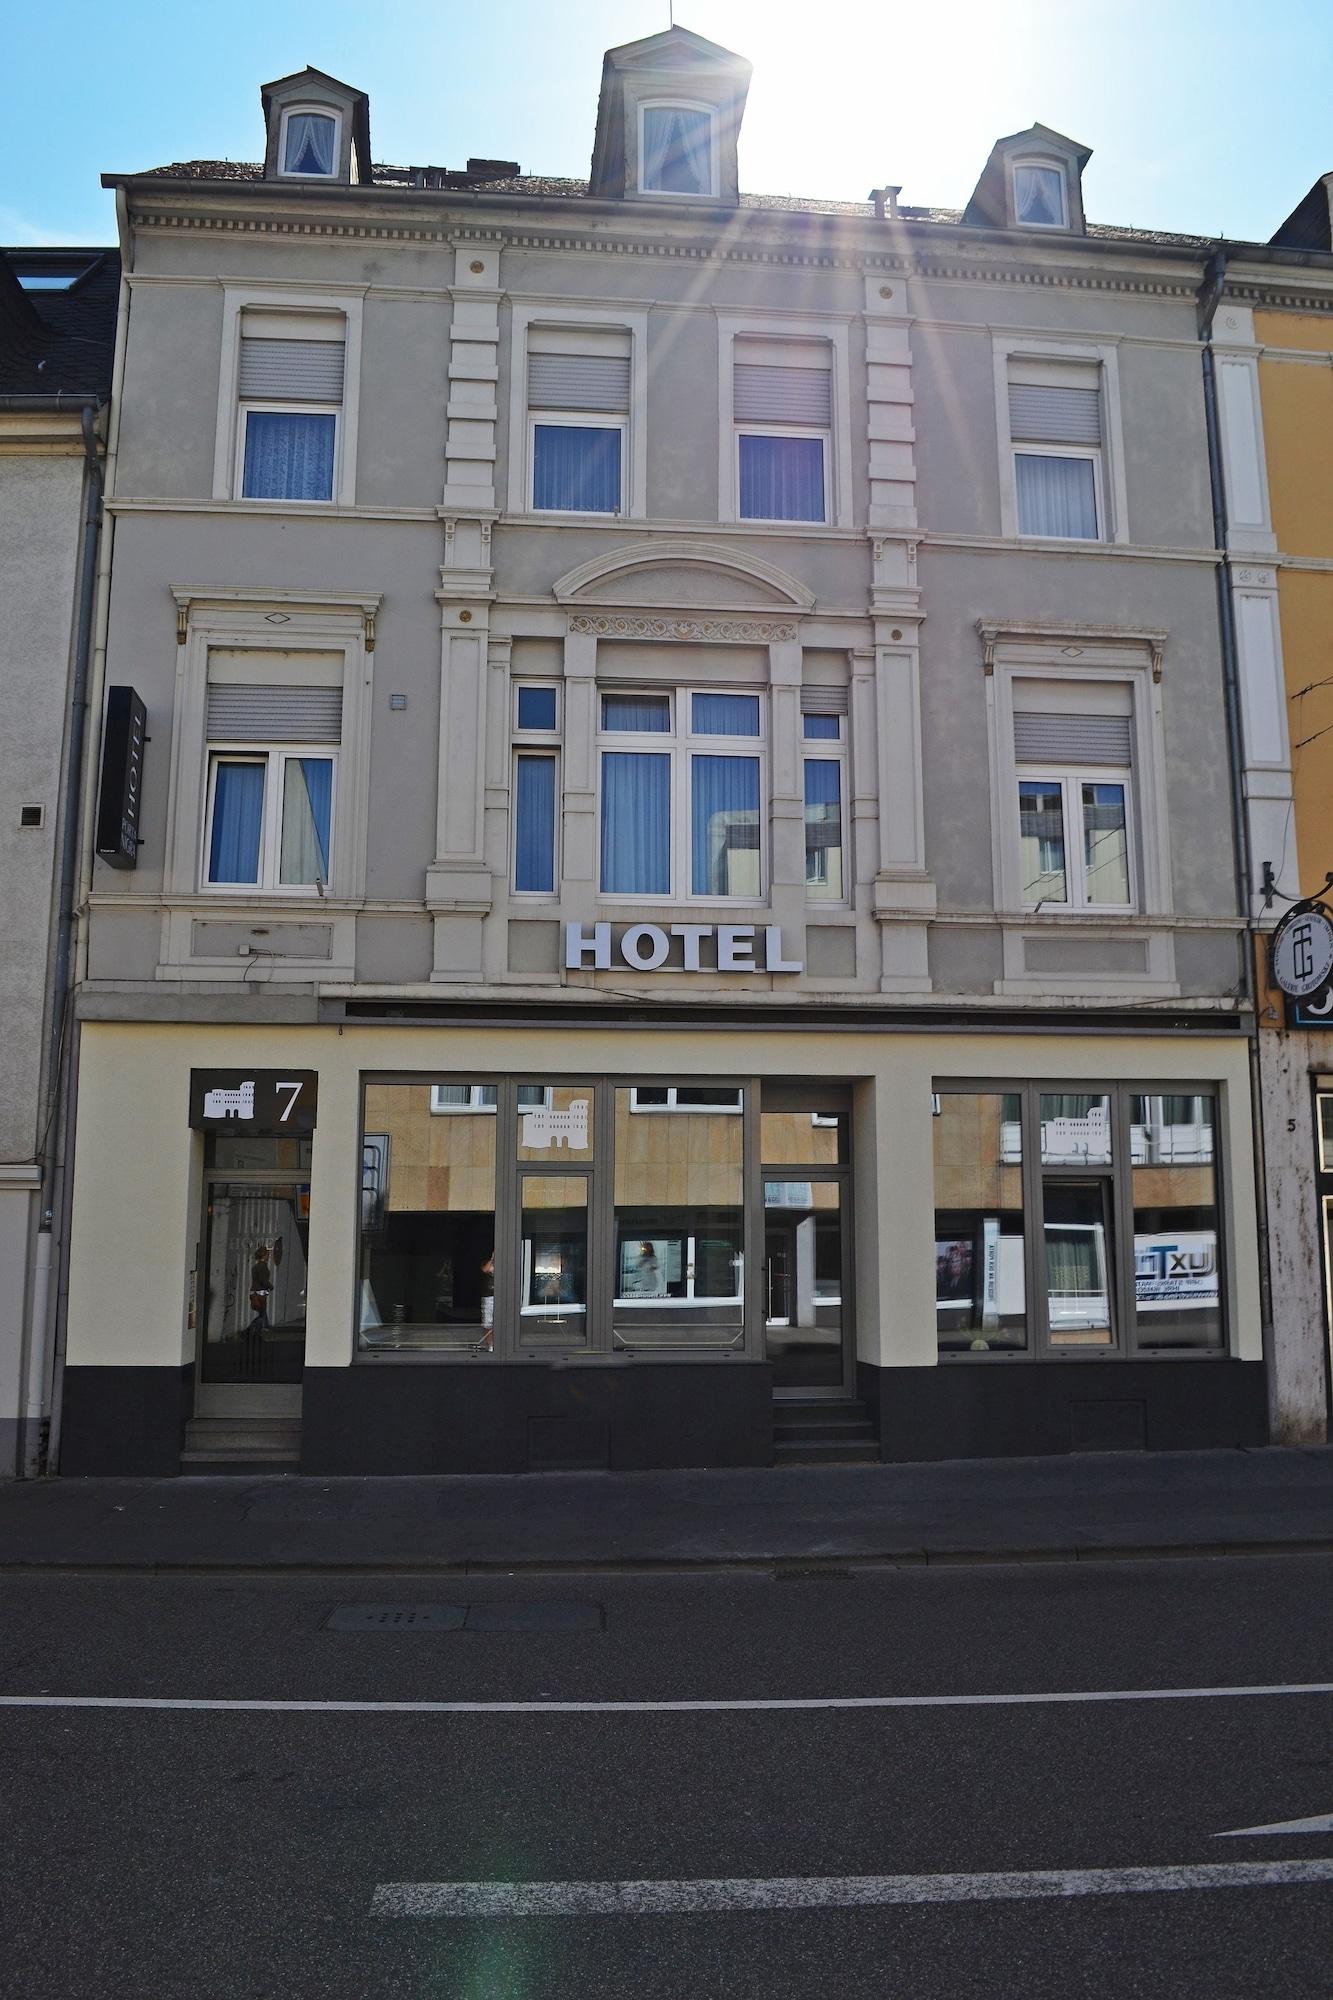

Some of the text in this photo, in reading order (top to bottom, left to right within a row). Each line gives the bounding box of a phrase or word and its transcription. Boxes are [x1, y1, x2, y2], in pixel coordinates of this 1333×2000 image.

[127, 711, 142, 818] HOTEL
[566, 921, 803, 972] HOTEL
[275, 1082, 303, 1122] 7
[1287, 1118, 1297, 1133] 5
